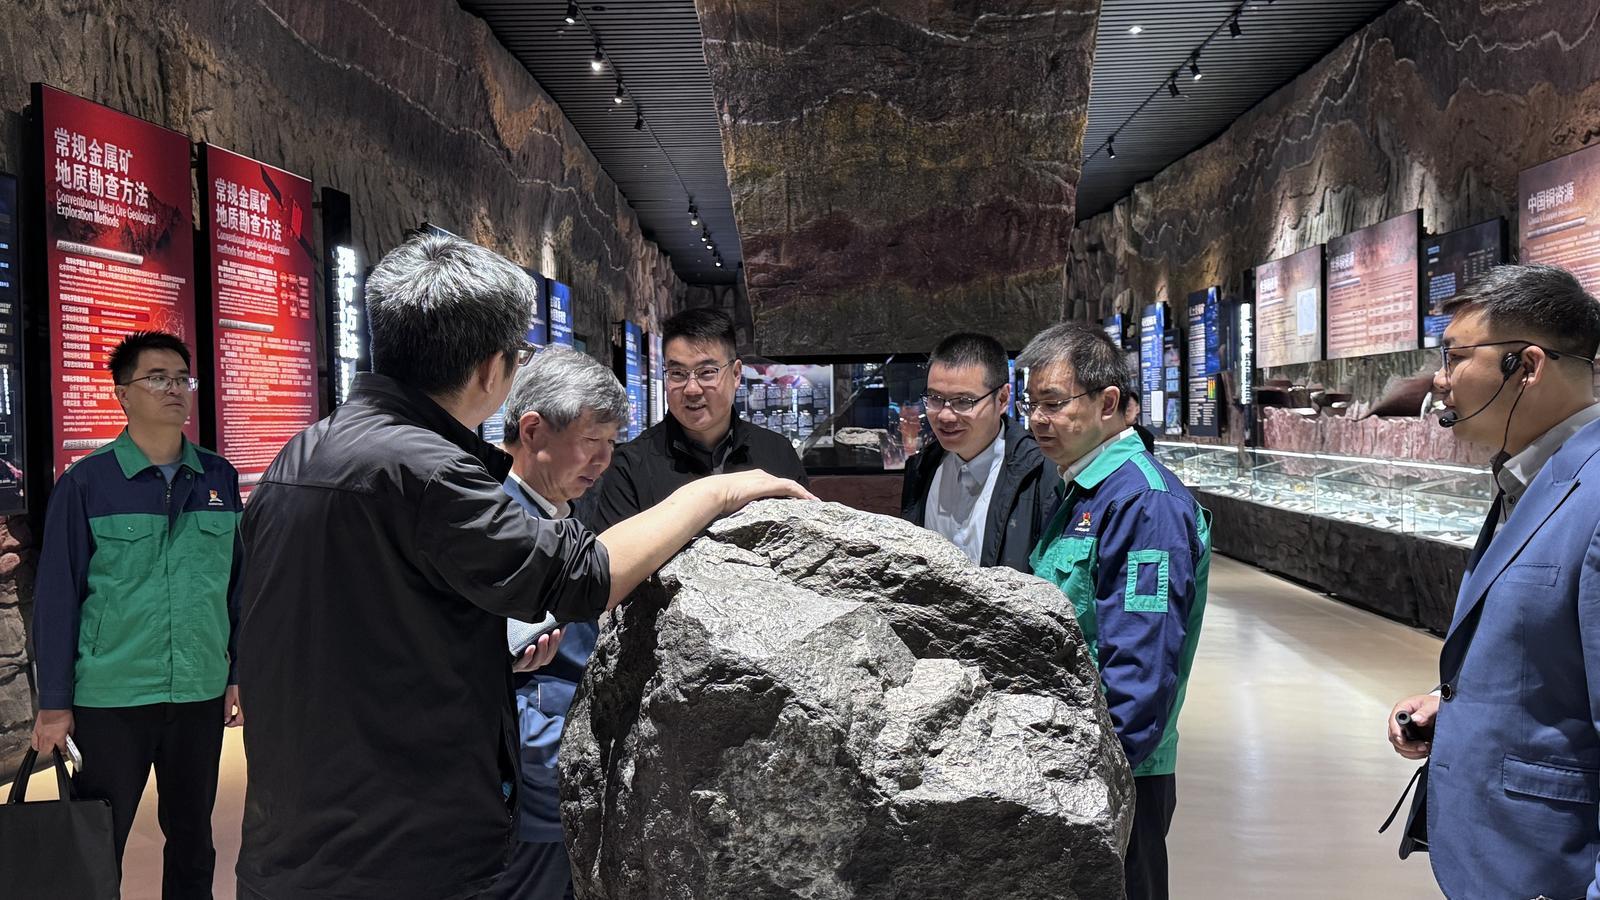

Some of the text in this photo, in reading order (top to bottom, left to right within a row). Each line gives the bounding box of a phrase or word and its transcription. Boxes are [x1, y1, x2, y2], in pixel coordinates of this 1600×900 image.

[54, 127, 133, 175] 常规金属矿
[55, 158, 149, 209] 地质勘查方法
[215, 177, 270, 215] 常规金属矿
[1527, 181, 1575, 214] 中国铜资源
[56, 189, 157, 226] Conventional Metal Ore Geological
[56, 201, 120, 228] Exploration Methods
[215, 203, 282, 242] 地质勘查方法
